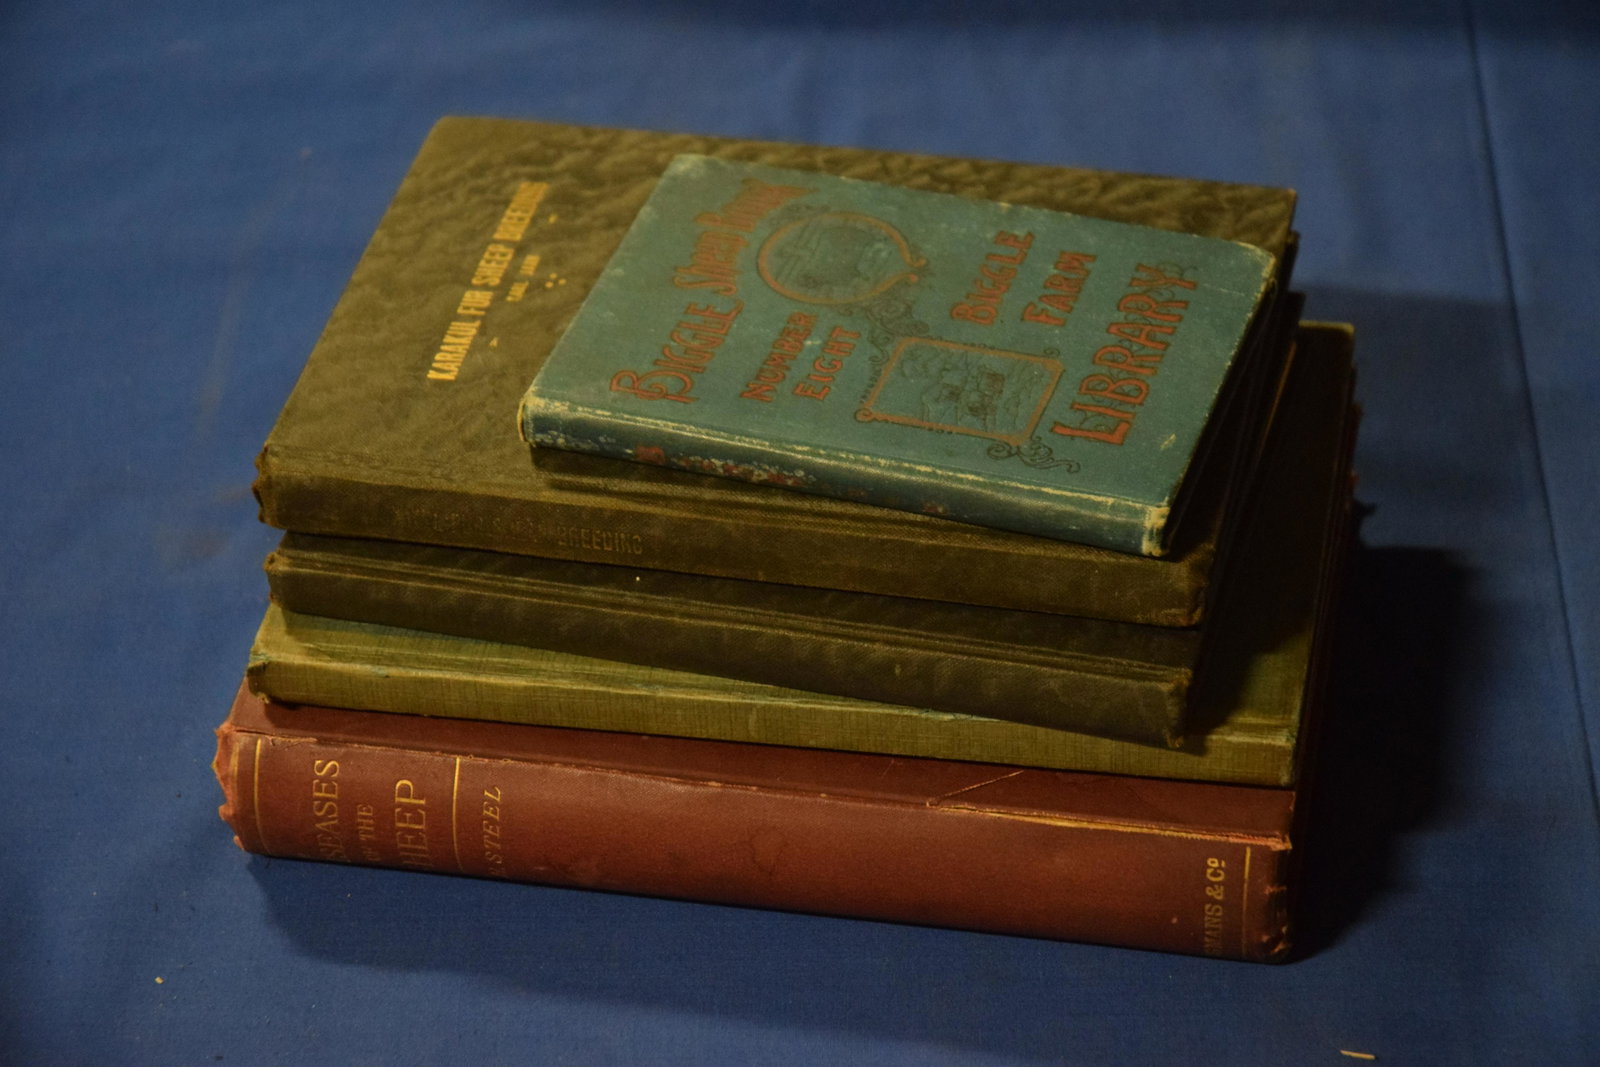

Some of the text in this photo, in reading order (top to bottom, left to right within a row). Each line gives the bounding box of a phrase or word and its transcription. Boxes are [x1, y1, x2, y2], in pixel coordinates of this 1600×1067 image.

[493, 181, 549, 241] BREE
[471, 243, 515, 287] SHEEP
[950, 230, 1035, 327] BIGGLE
[1021, 250, 1097, 327] FARM
[457, 289, 494, 316] FUR
[427, 320, 481, 380] KARAKUL
[610, 299, 745, 404] BIGGLE
[739, 310, 818, 402] NUMBER
[792, 324, 861, 400] EIGHT
[1051, 262, 1197, 446] LIBRARY
[355, 802, 378, 842] THE
[1205, 884, 1225, 900] &
